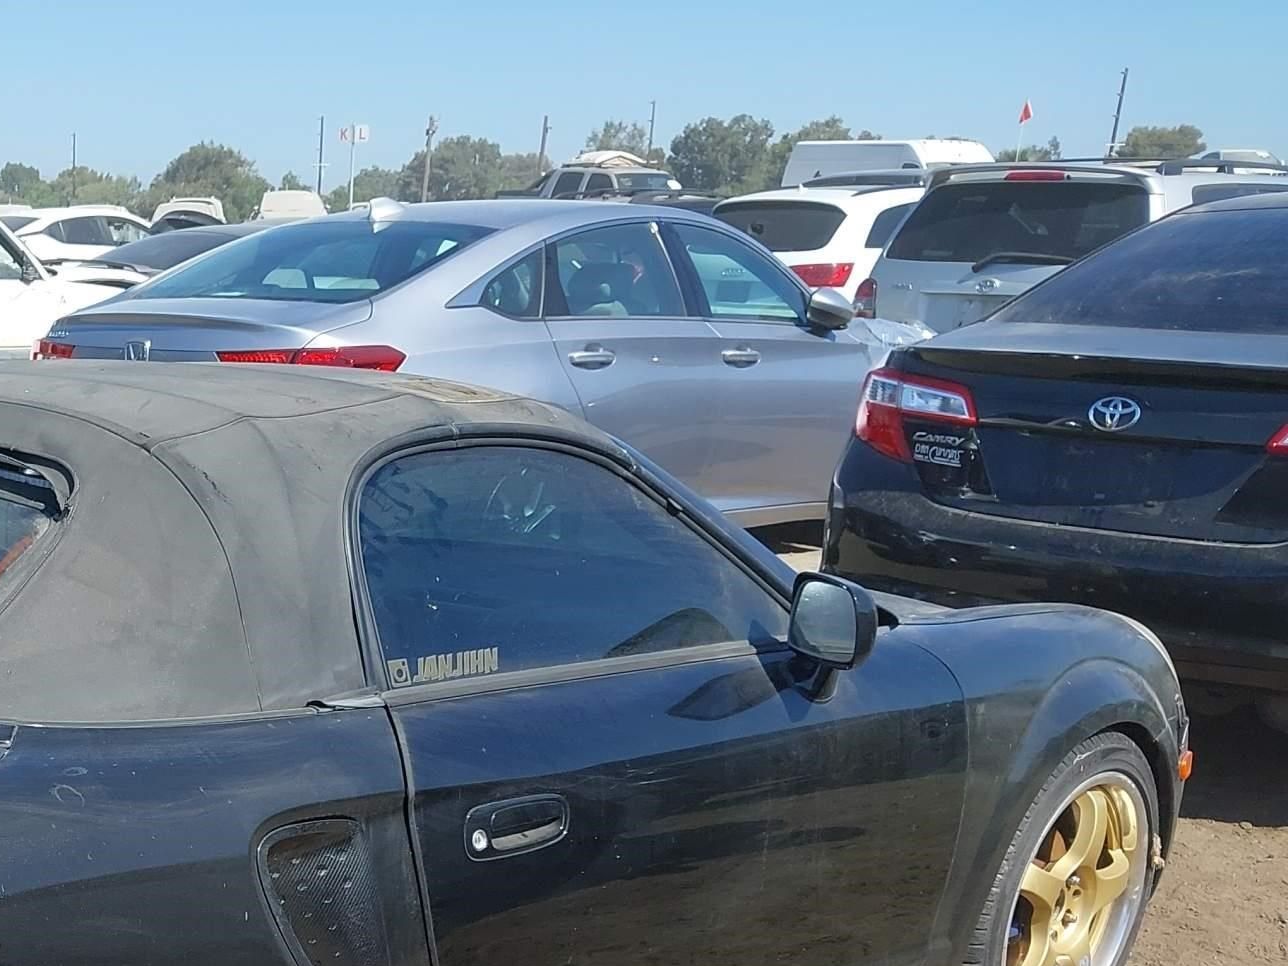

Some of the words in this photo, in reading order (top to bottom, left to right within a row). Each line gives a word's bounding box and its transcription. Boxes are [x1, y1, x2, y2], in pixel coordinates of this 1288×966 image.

[339, 127, 349, 141] K
[358, 127, 367, 140] L
[412, 646, 499, 683] JANJIHN
